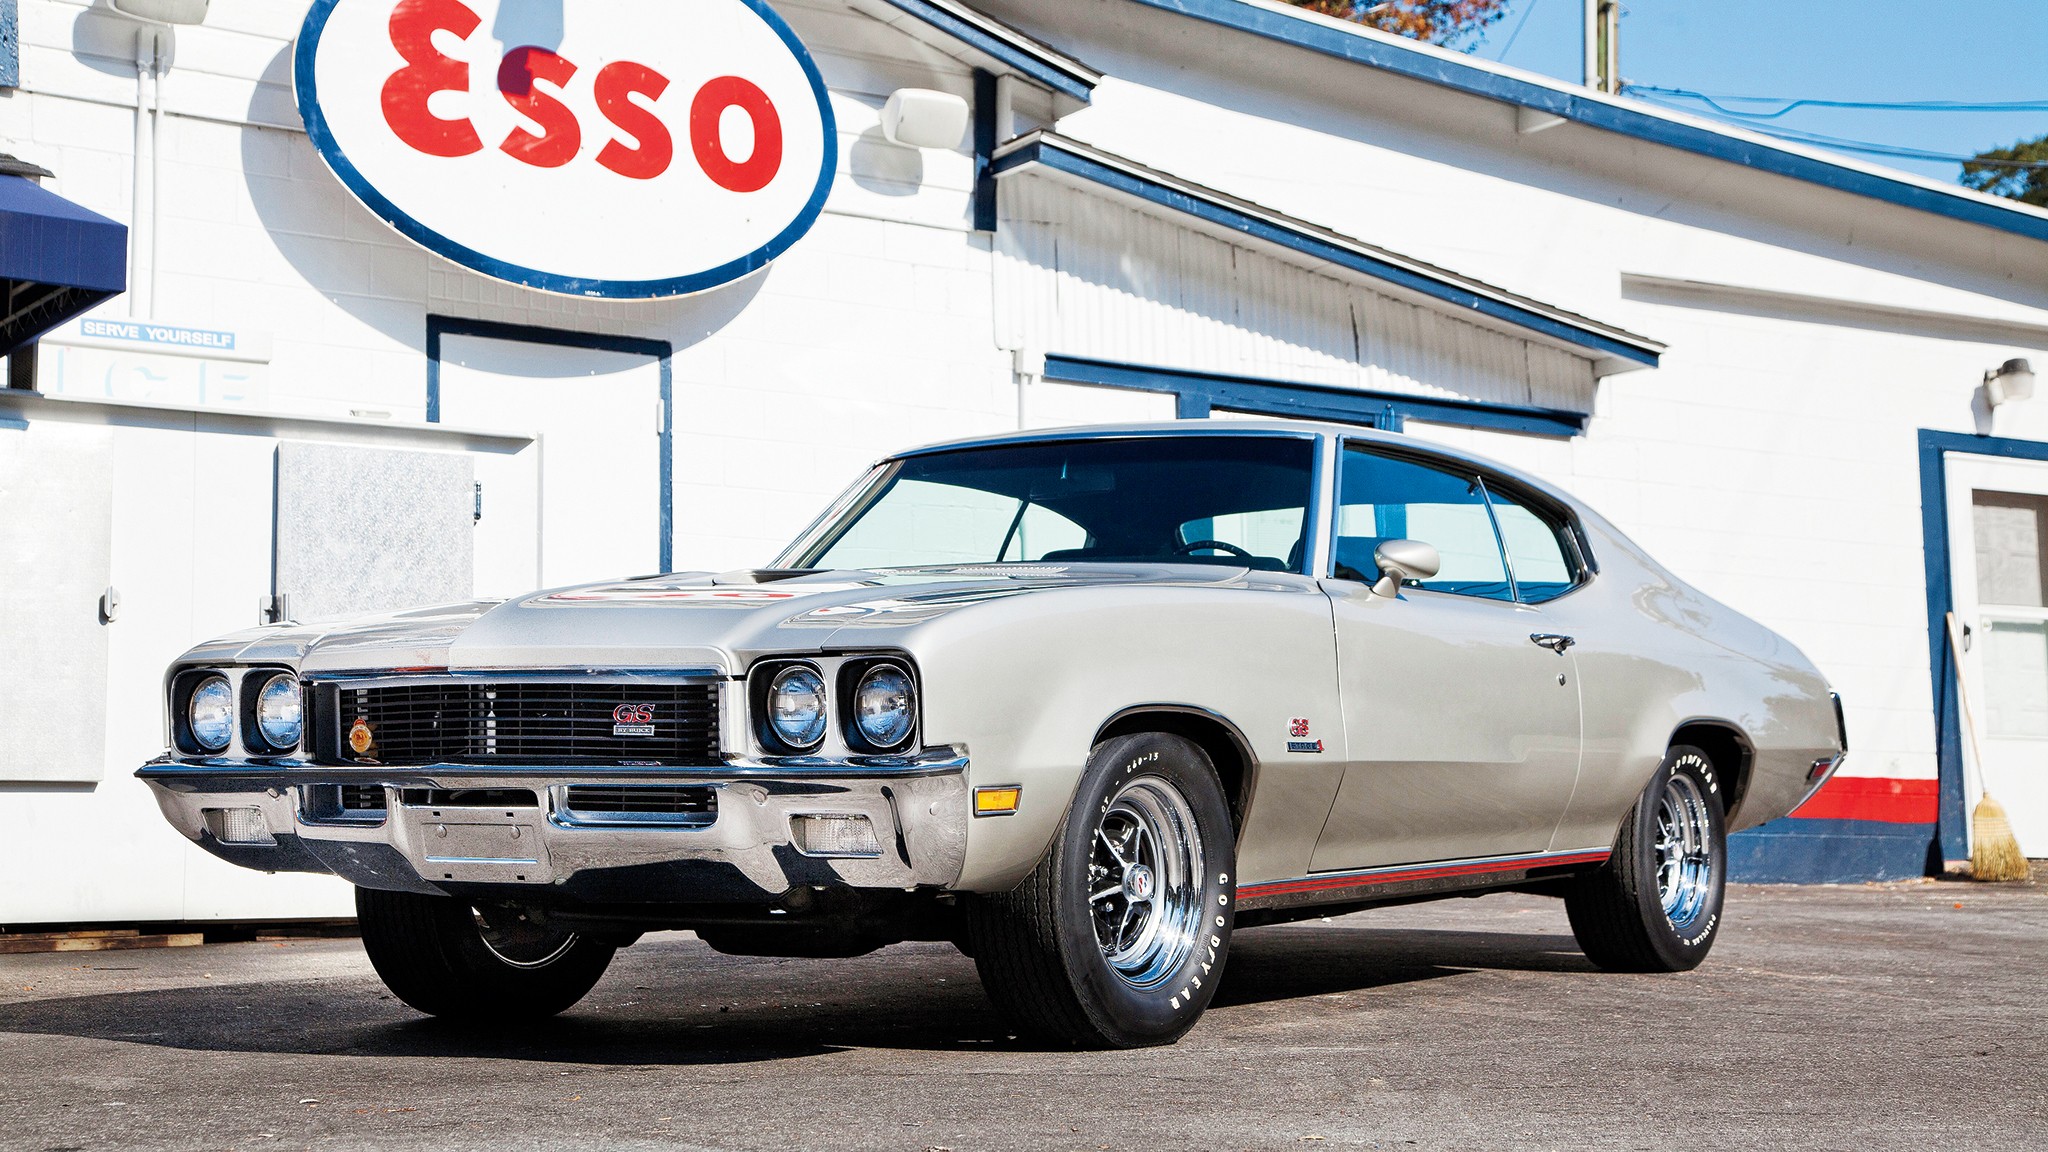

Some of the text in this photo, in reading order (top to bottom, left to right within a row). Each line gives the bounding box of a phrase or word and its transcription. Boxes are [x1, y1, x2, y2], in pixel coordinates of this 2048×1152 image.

[83, 320, 232, 348] SERVE YOURSELF
[612, 703, 656, 723] GS
[1670, 754, 1717, 794] GOODYEAR
[1169, 872, 1229, 1011] GOODYEAR
